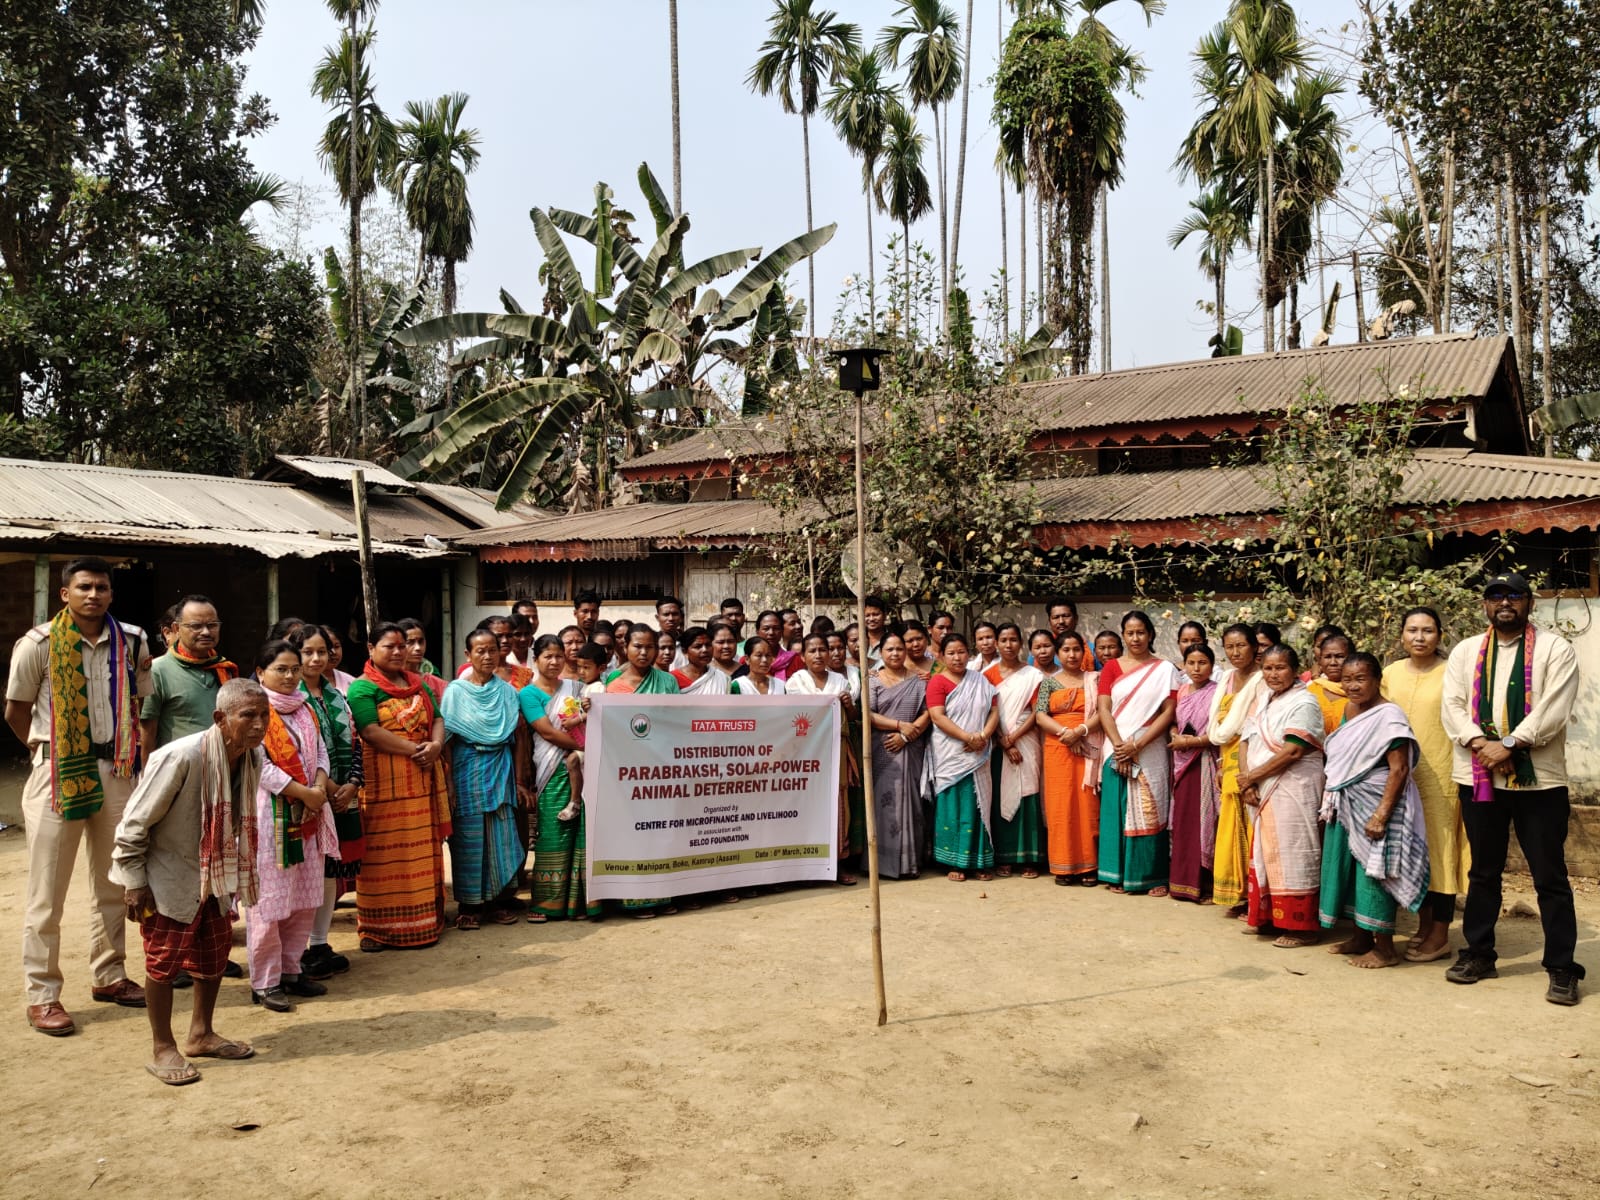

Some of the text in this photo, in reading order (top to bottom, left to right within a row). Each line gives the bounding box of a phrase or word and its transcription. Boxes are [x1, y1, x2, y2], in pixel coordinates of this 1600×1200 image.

[693, 721, 754, 731] TATA TRUSTS
[673, 744, 773, 759] DISTRIBUTION OF
[618, 759, 820, 781] PARABRAKSH, SOLAR-POWER
[631, 777, 808, 800] ANIMAL DETERRENT LIGHT
[703, 804, 739, 814] Organized by
[634, 810, 798, 831] CENTRE FOR MICROFINANCE AND LIVELIHOOD
[689, 834, 750, 847] SELCO FOUNDATION
[754, 850, 769, 859] Date
[604, 863, 630, 871] Venue
